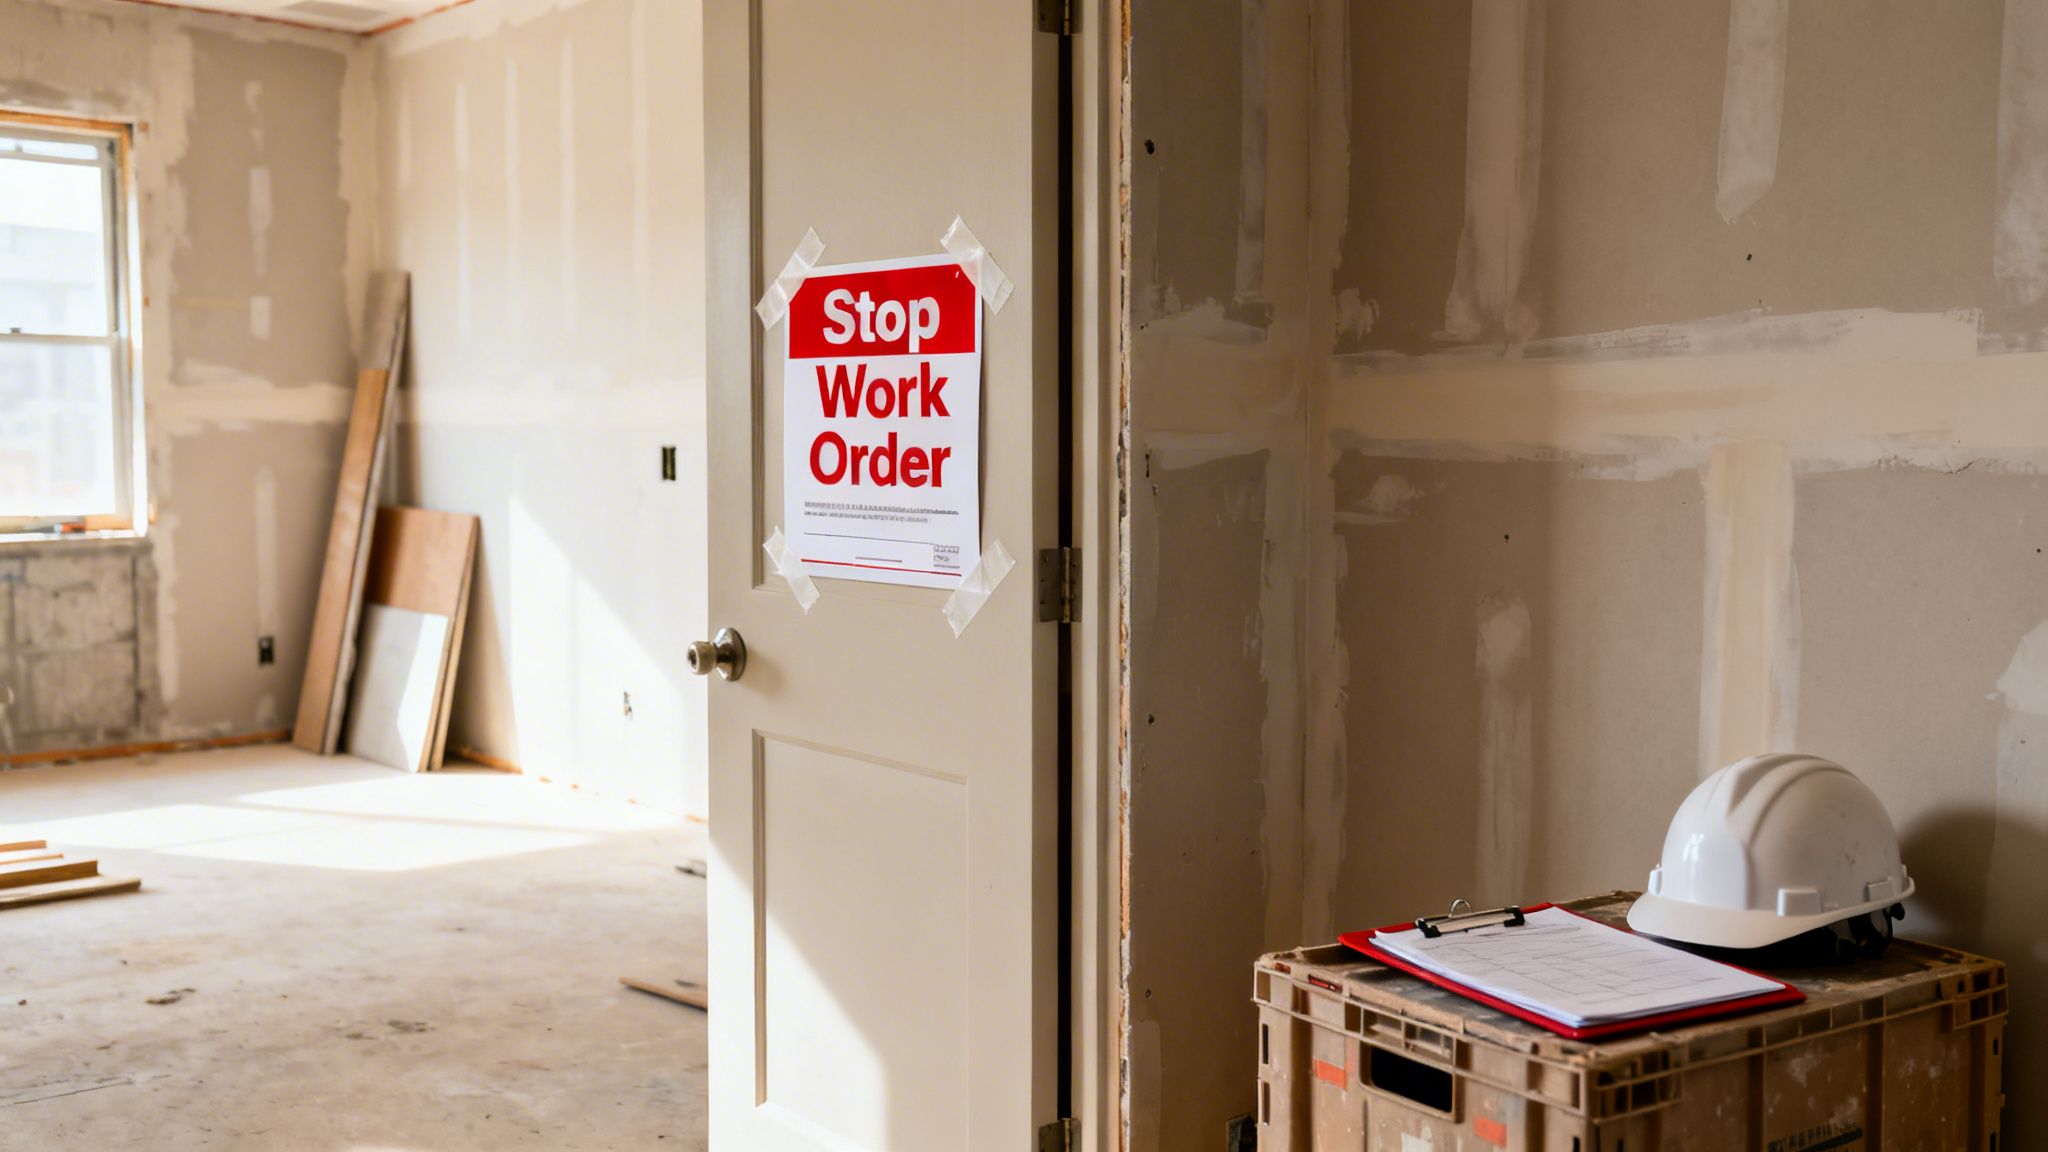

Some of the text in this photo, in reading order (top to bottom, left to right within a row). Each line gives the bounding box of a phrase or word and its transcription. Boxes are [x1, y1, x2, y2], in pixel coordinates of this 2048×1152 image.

[823, 288, 940, 354] Stop
[816, 362, 950, 419] Work
[810, 431, 951, 488] Order
